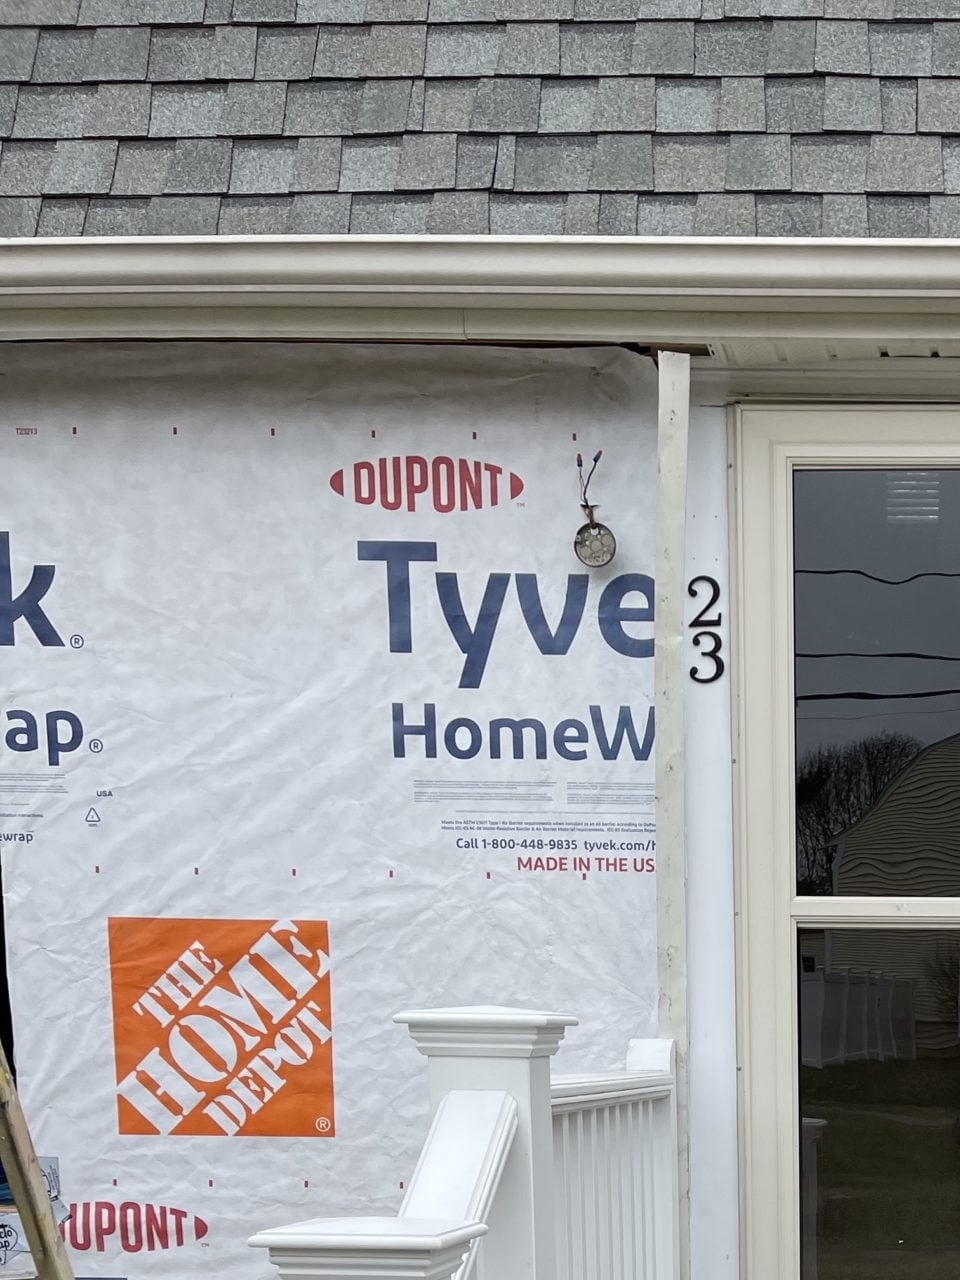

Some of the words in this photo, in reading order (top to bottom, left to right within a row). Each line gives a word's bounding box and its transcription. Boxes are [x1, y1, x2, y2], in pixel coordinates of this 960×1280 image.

[354, 456, 502, 513] DUPONT
[457, 838, 478, 848] Call
[482, 839, 577, 849] 1-800-448-9835
[518, 857, 567, 871] MADE
[574, 857, 590, 871] IN
[595, 858, 627, 872] THE
[633, 857, 656, 873] US
[132, 940, 224, 1029] THE
[116, 919, 330, 1136] HOME
[202, 1000, 332, 1136] DEPOT
